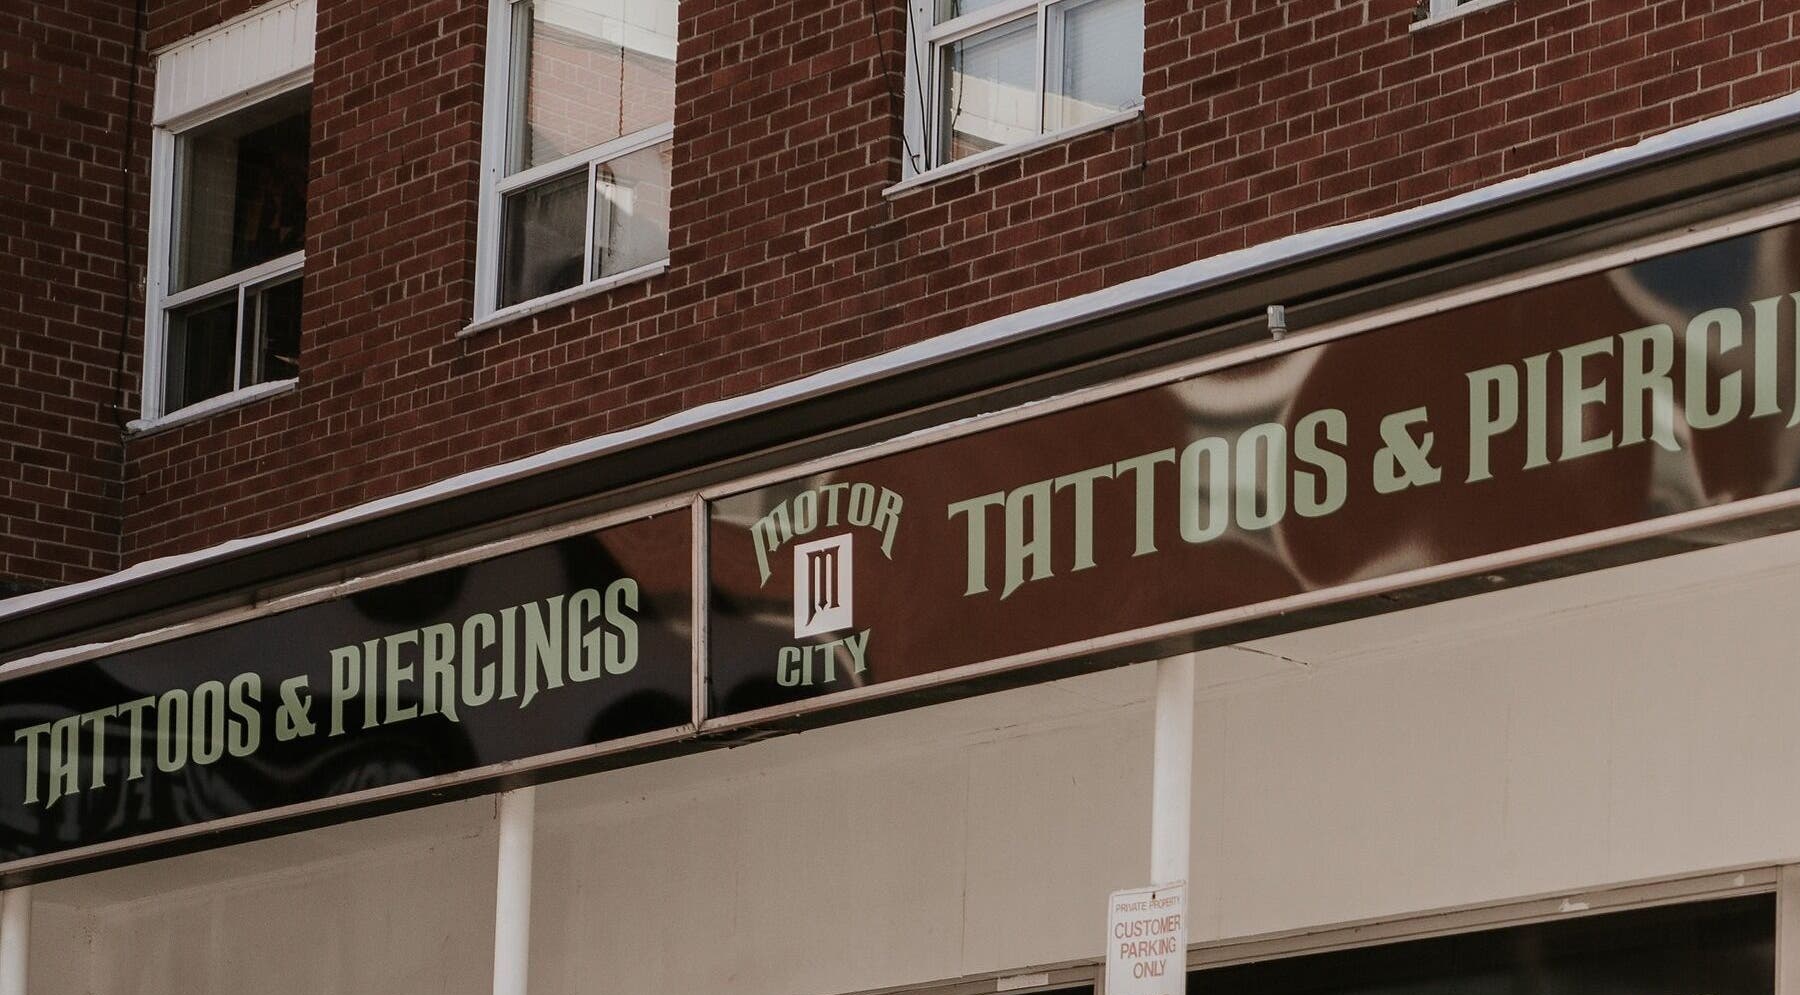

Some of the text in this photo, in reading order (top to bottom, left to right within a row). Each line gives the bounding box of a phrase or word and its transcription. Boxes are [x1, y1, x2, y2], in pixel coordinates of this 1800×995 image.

[948, 408, 1348, 600] TATTOOS
[1373, 406, 1441, 494] &
[750, 482, 904, 589] MOTOR
[776, 627, 871, 687] CITY
[15, 577, 639, 808] TATTOOS & PIERCINGS
[1114, 915, 1181, 939] CUSTOMER
[1120, 936, 1176, 959] PARKING
[1133, 960, 1166, 979] ONLY
